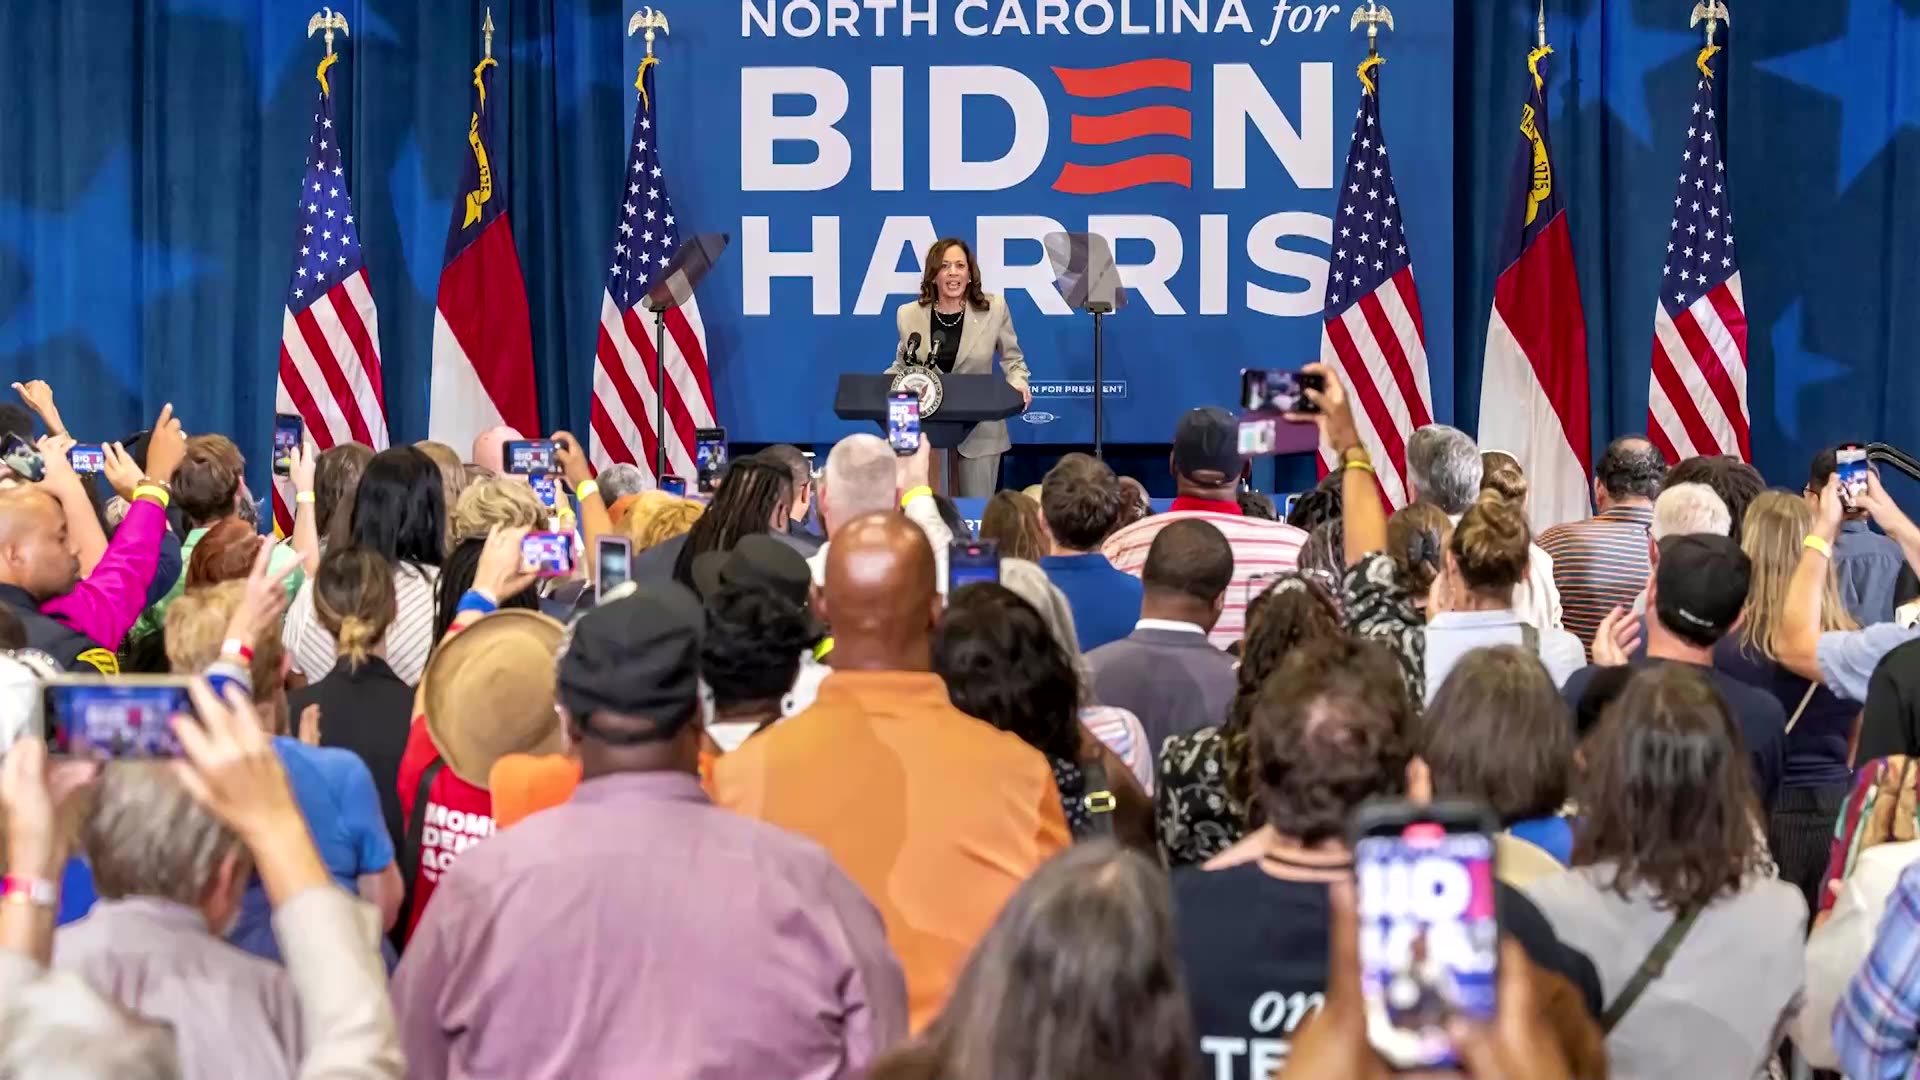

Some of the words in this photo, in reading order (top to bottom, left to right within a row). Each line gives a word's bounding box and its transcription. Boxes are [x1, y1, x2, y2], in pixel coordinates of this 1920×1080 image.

[741, 0, 938, 37] NORTH
[954, 0, 1253, 36] CAROLINA
[1260, 0, 1340, 46] for
[741, 58, 1333, 193] BIDEN
[741, 211, 1333, 317] HARRIS
[1041, 385, 1062, 393] FOR
[1064, 385, 1123, 393] PRESIENT
